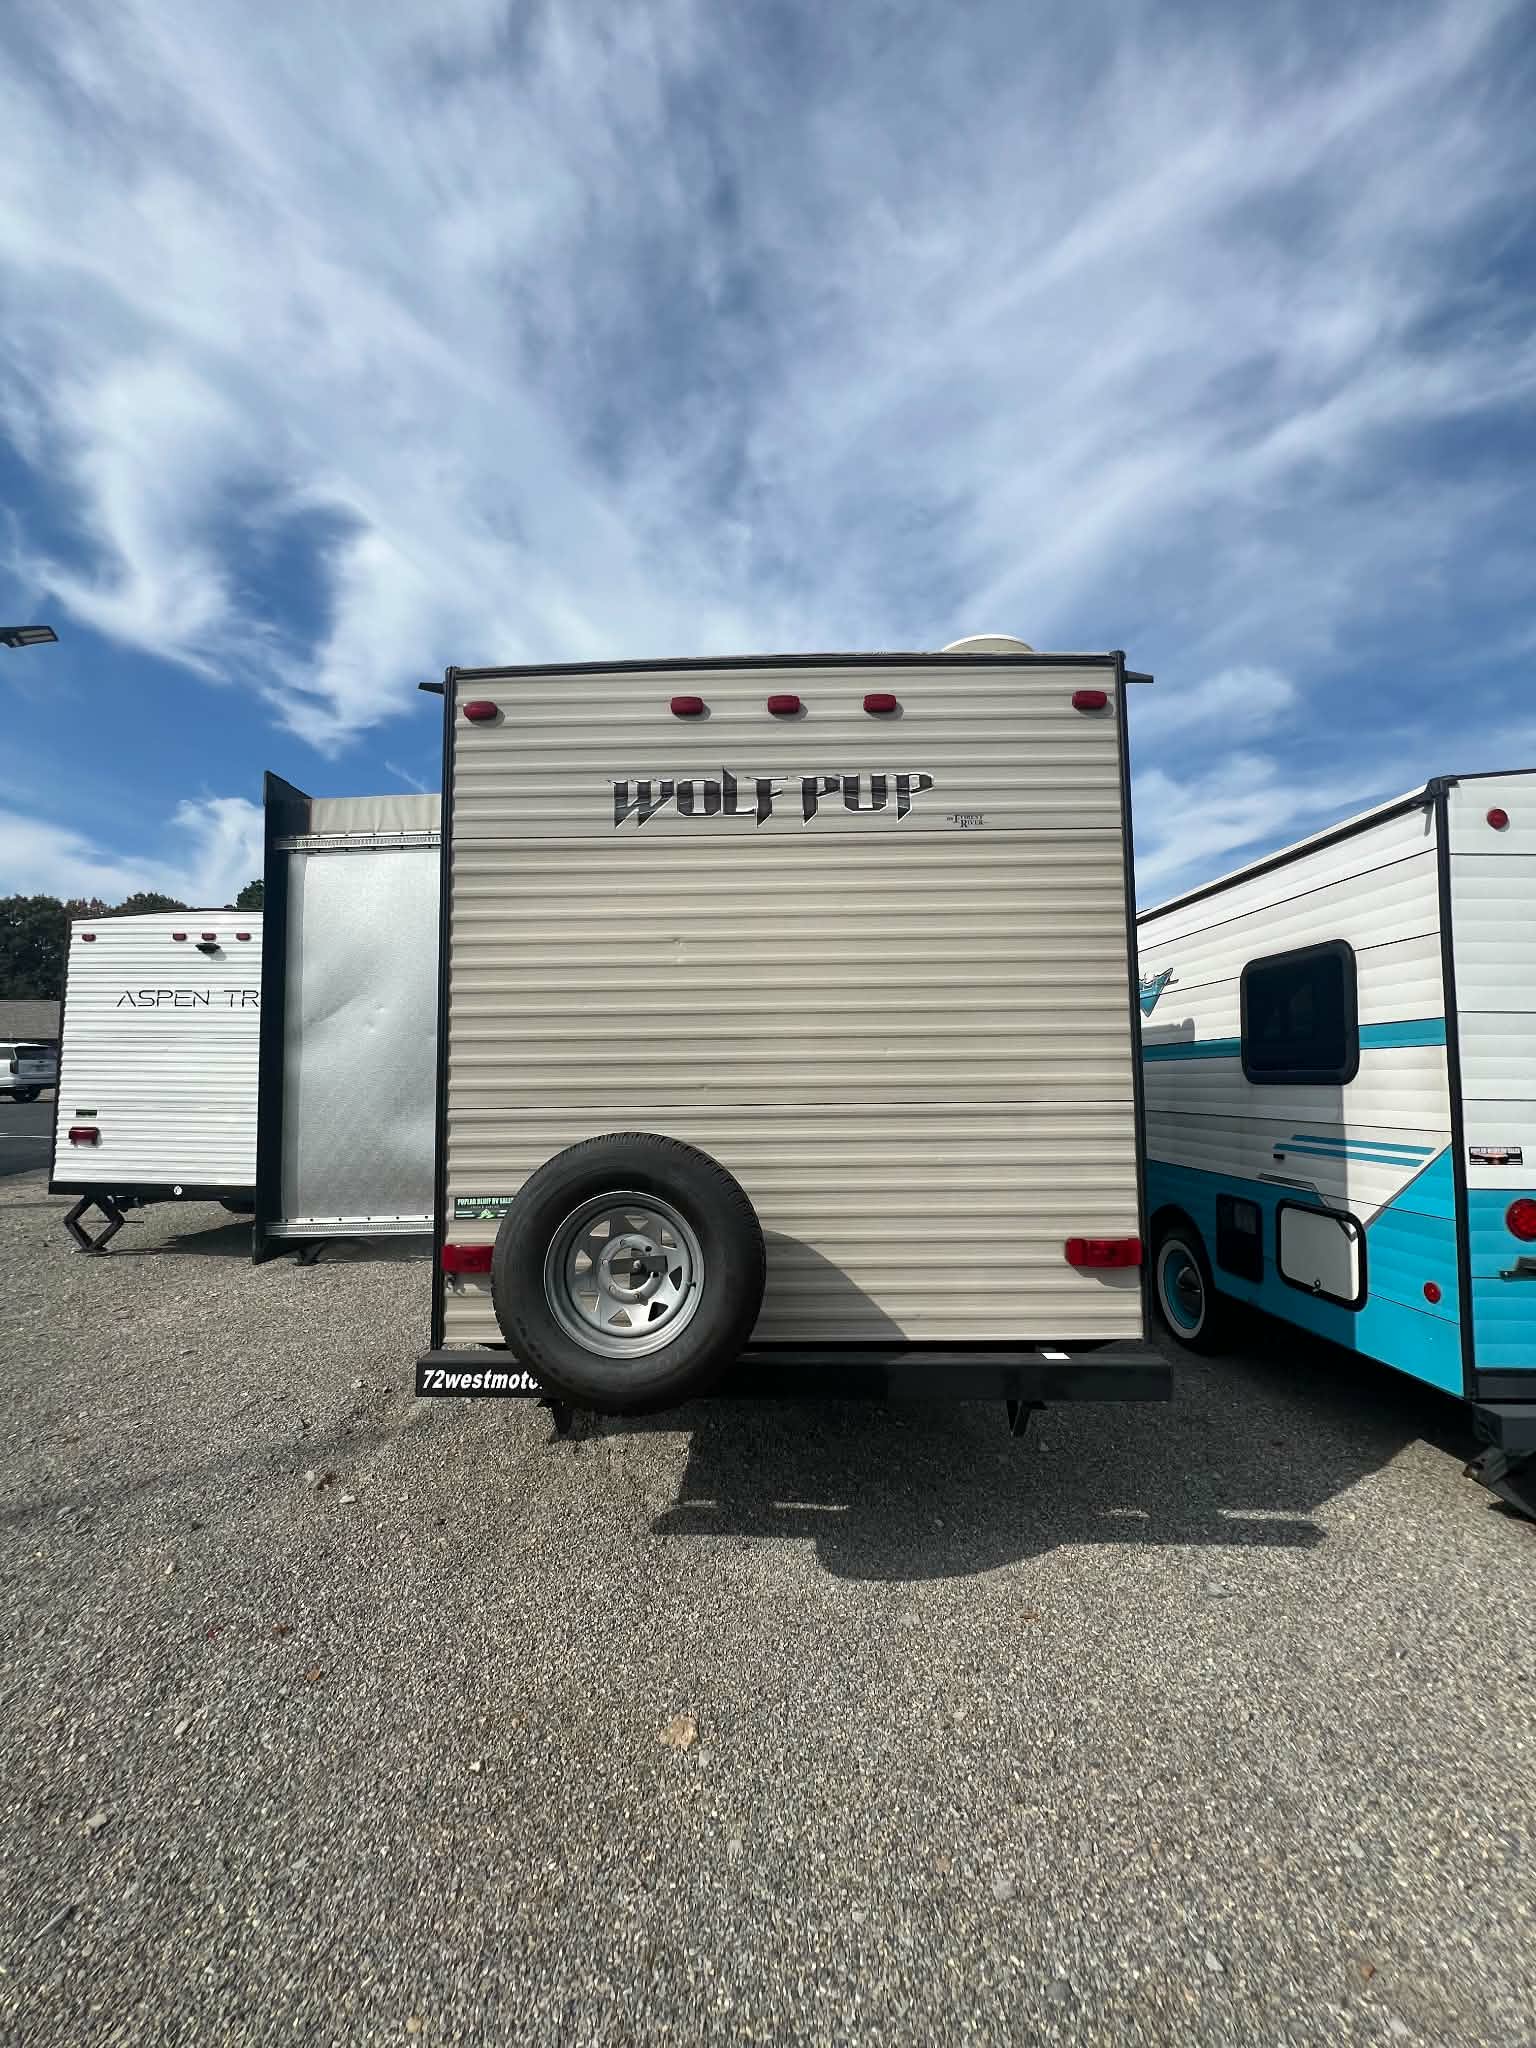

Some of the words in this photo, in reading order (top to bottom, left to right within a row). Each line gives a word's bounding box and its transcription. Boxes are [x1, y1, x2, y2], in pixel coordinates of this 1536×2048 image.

[607, 766, 788, 829] WOLF
[798, 772, 935, 826] PUP
[117, 990, 210, 1007] ASPEN
[224, 990, 260, 1007] TR
[422, 1368, 543, 1390] 72westmoto
